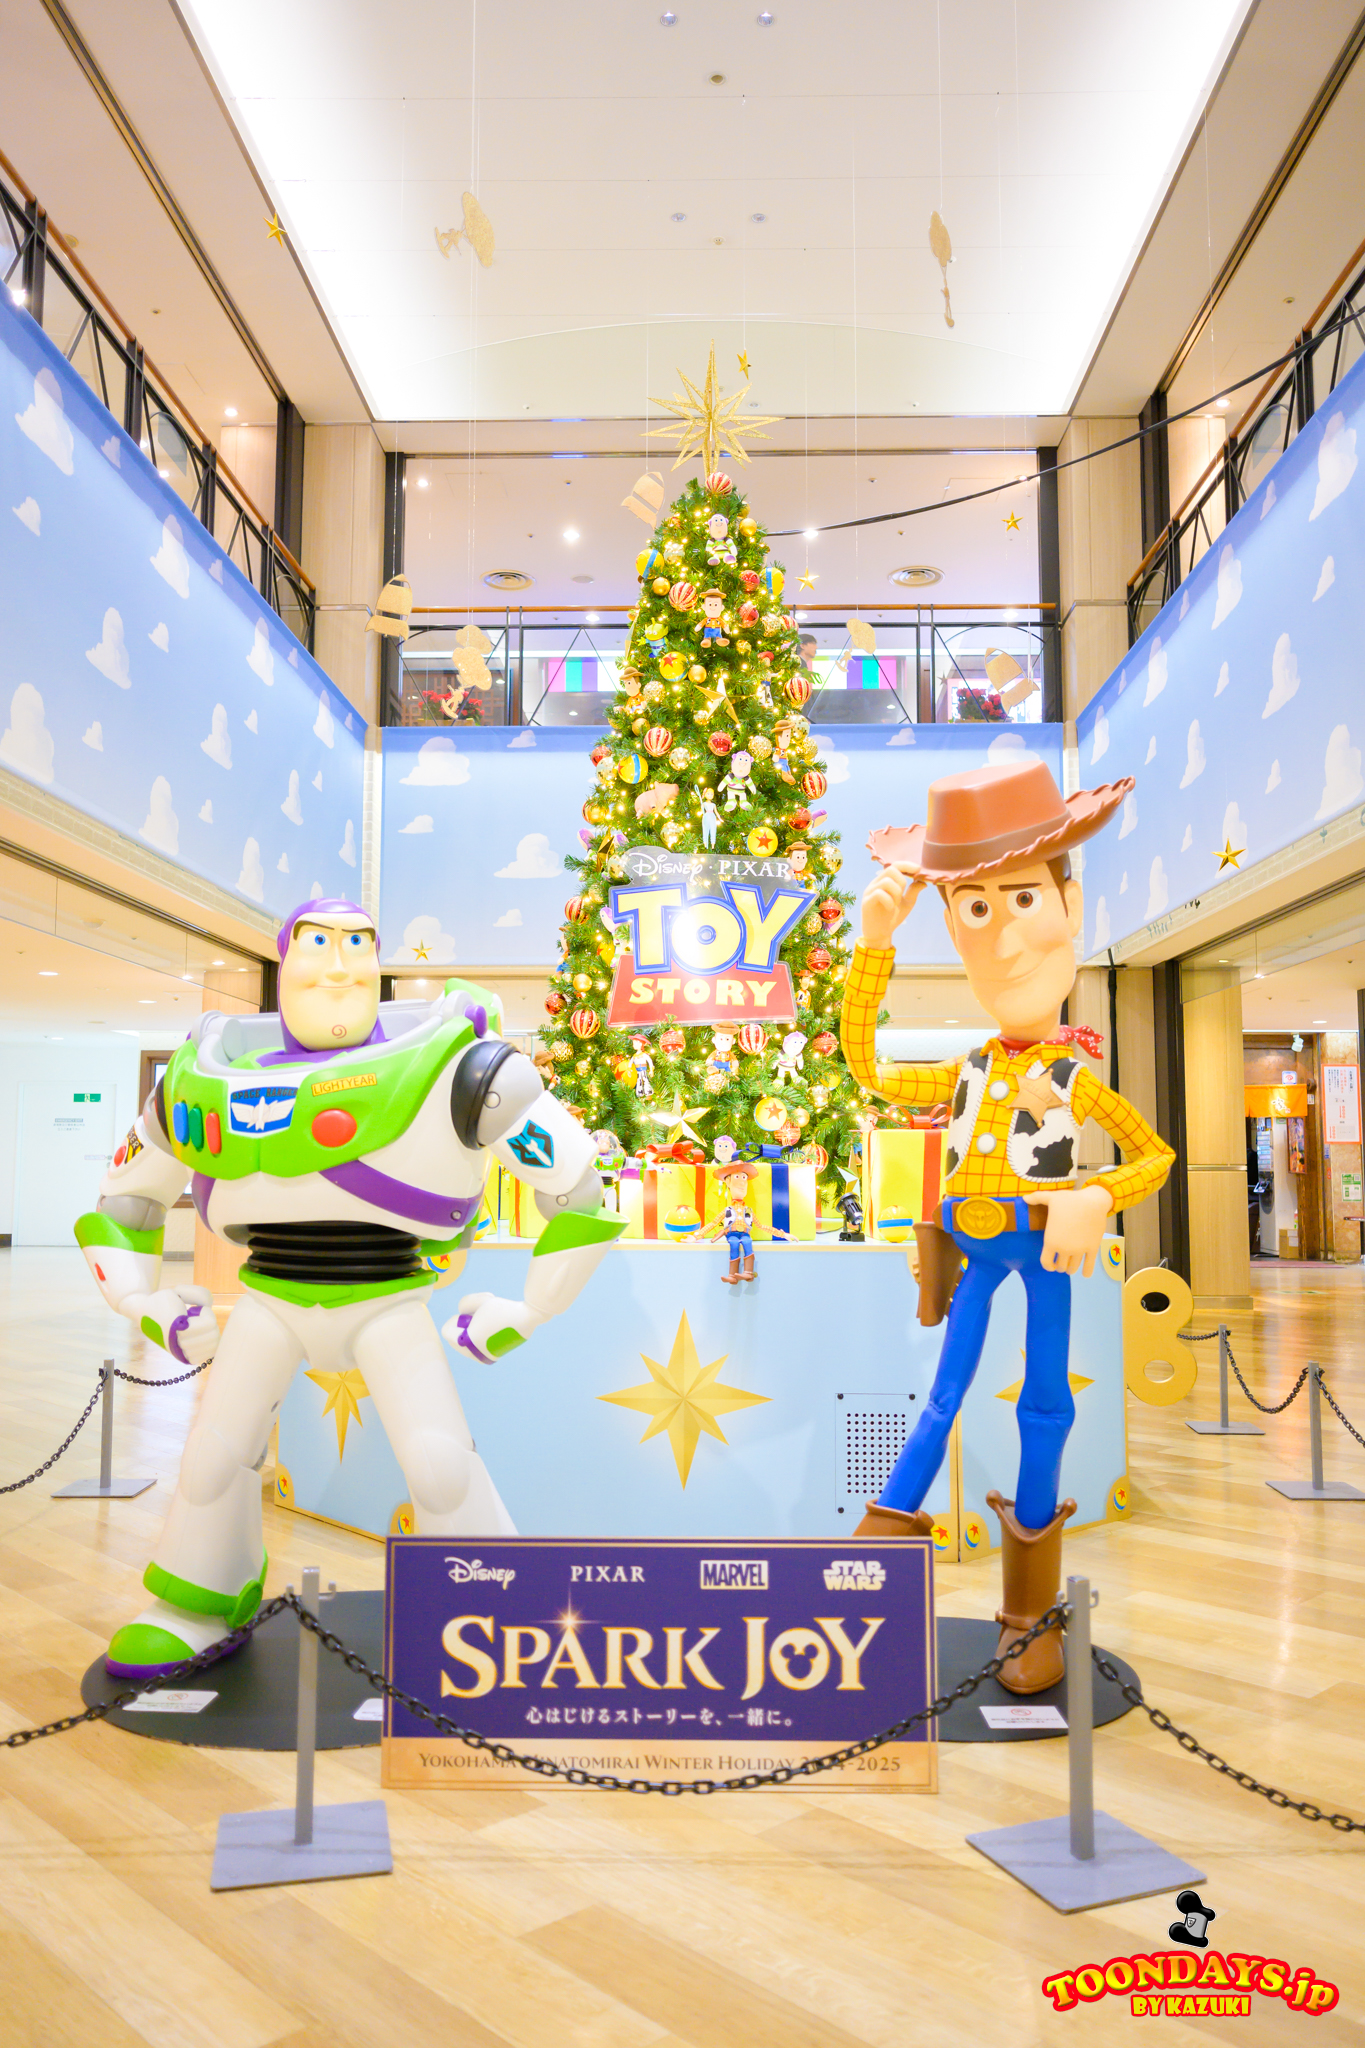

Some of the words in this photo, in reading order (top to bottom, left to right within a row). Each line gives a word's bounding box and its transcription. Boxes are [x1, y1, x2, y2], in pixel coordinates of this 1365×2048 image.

[718, 860, 790, 878] PIXAR
[613, 881, 817, 976] TOY
[629, 978, 778, 1008] STORY
[232, 1089, 261, 1100] SPACE
[313, 1075, 375, 1095] LIGHTYEAR
[570, 1565, 645, 1583] PIXAR
[702, 1561, 767, 1588] MARVEL
[823, 1560, 886, 1575] STAR
[824, 1575, 886, 1591] WARS
[440, 1614, 725, 1699] SPARK
[741, 1616, 886, 1701] JOY
[525, 1706, 793, 1727] 心はじけるストーリーを、一緒に。
[644, 1755, 712, 1771] WINTER
[718, 1755, 795, 1771] HOLIDAY
